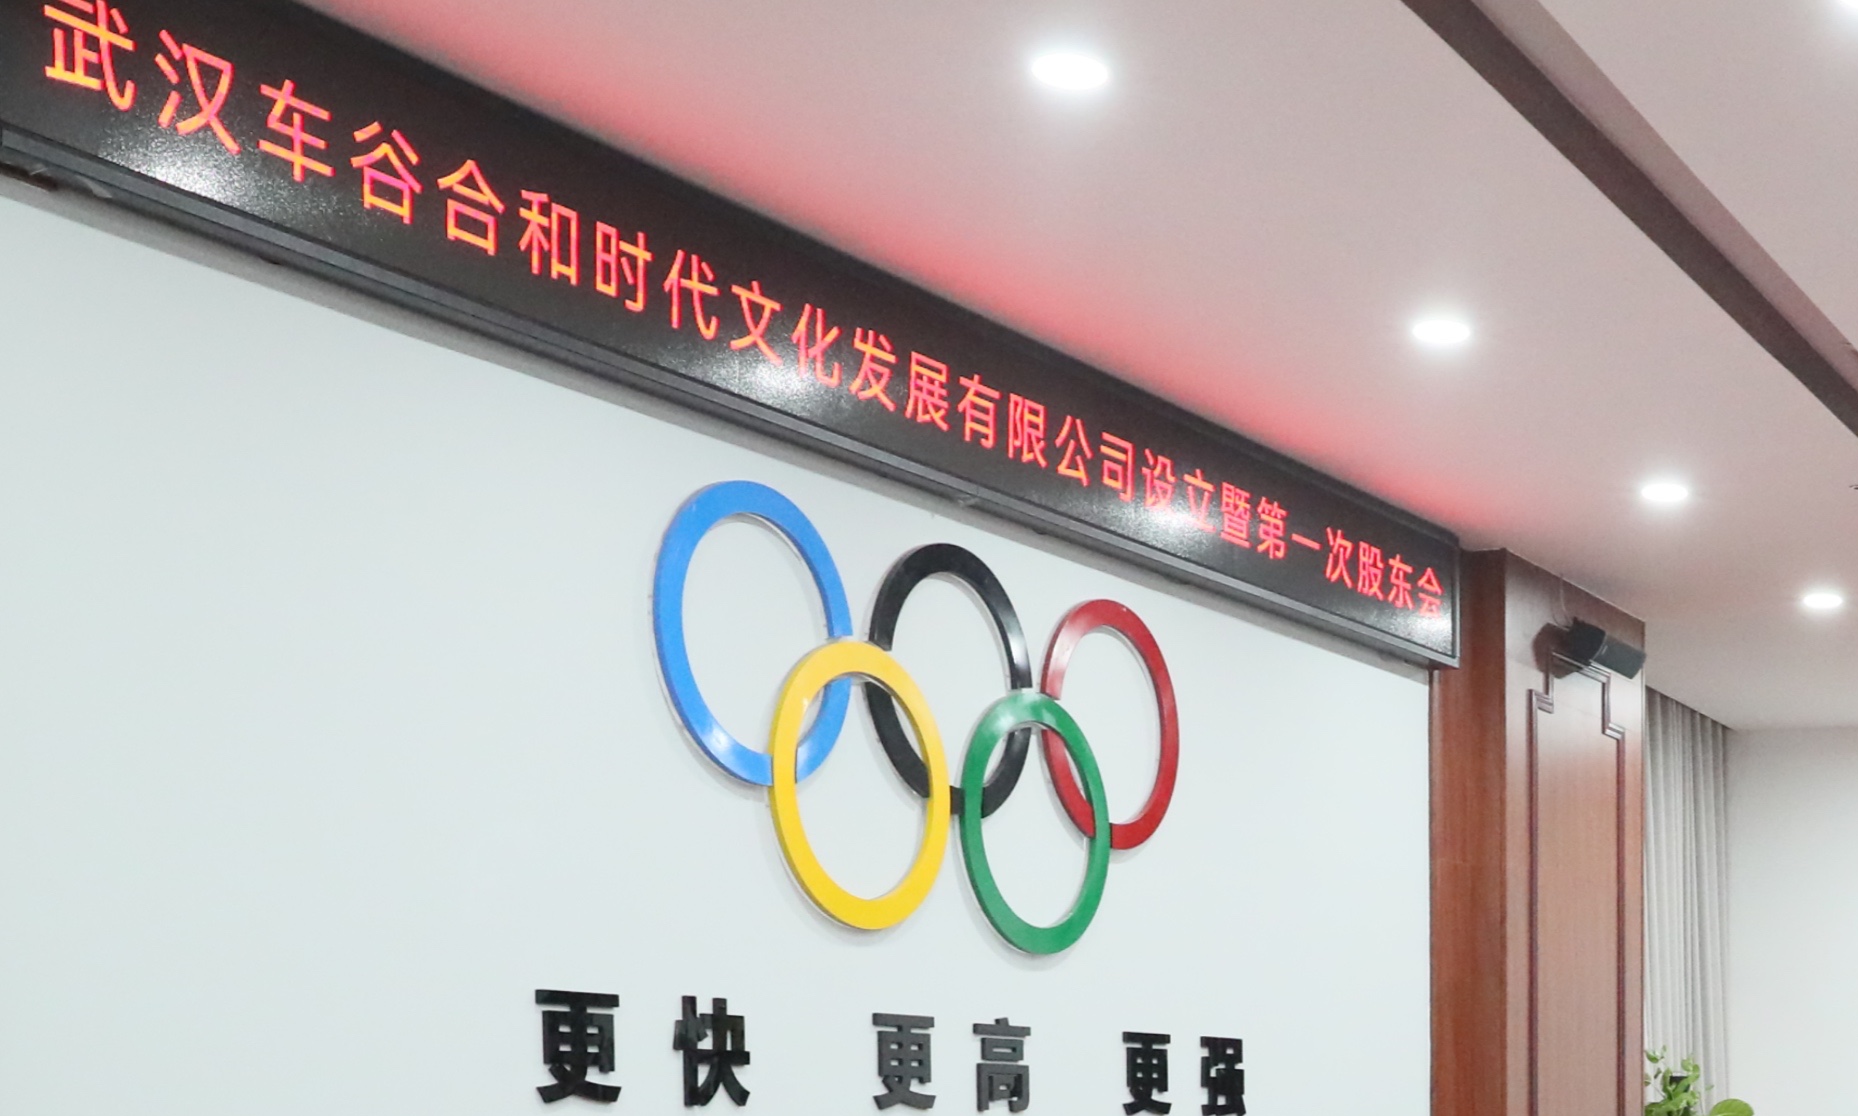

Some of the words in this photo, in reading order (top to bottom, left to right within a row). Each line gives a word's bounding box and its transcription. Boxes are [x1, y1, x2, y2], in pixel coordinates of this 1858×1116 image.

[44, 0, 1443, 619] 武汉车谷合和时代文化发展有限公司设立暨第一次股东会
[535, 989, 751, 1107] 更快
[872, 1013, 1031, 1113] 更高
[1122, 1031, 1246, 1116] 更强
